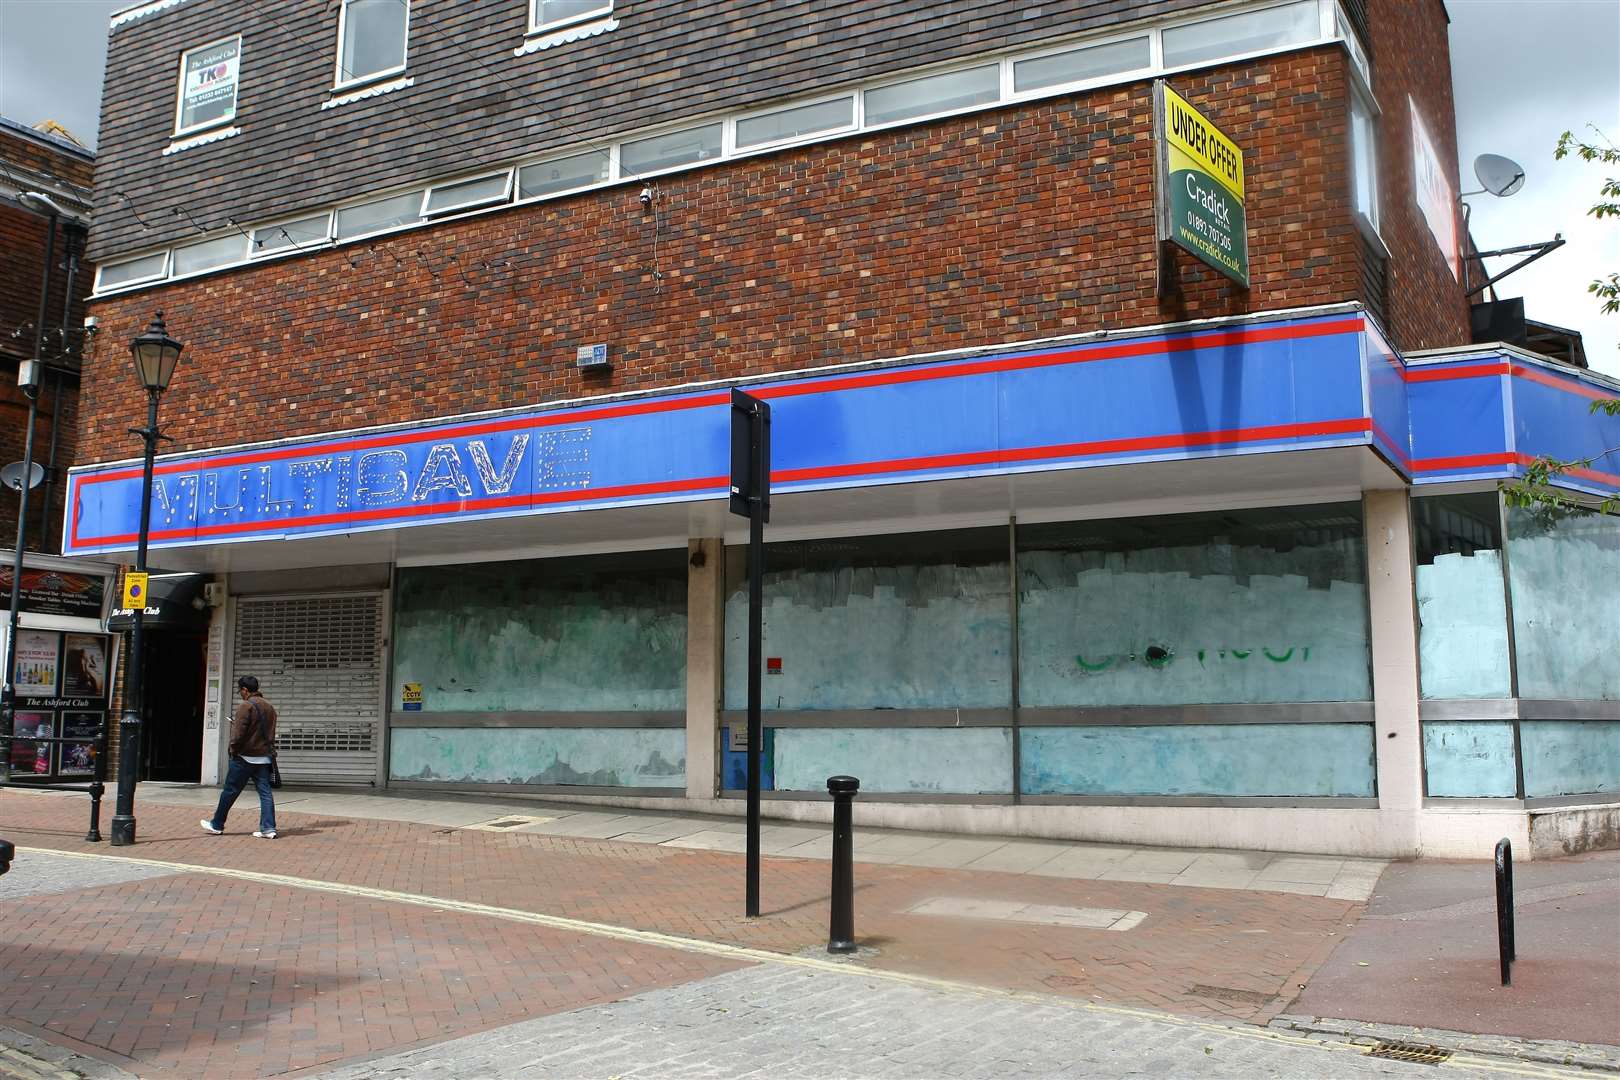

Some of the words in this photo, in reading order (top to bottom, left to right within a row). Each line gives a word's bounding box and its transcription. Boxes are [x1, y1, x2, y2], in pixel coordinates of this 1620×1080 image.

[1171, 101, 1207, 159] UNDER
[1209, 134, 1238, 184] OFFER
[1186, 172, 1230, 225] Cradick
[1179, 225, 1240, 272] www.cradick.co.uk
[1187, 210, 1208, 236] 01892
[1208, 225, 1232, 251] 707505
[151, 426, 592, 523] MULTISAVE
[143, 606, 160, 615] Club
[26, 698, 40, 706] The
[42, 697, 71, 708] Ashford
[72, 699, 89, 707] Club
